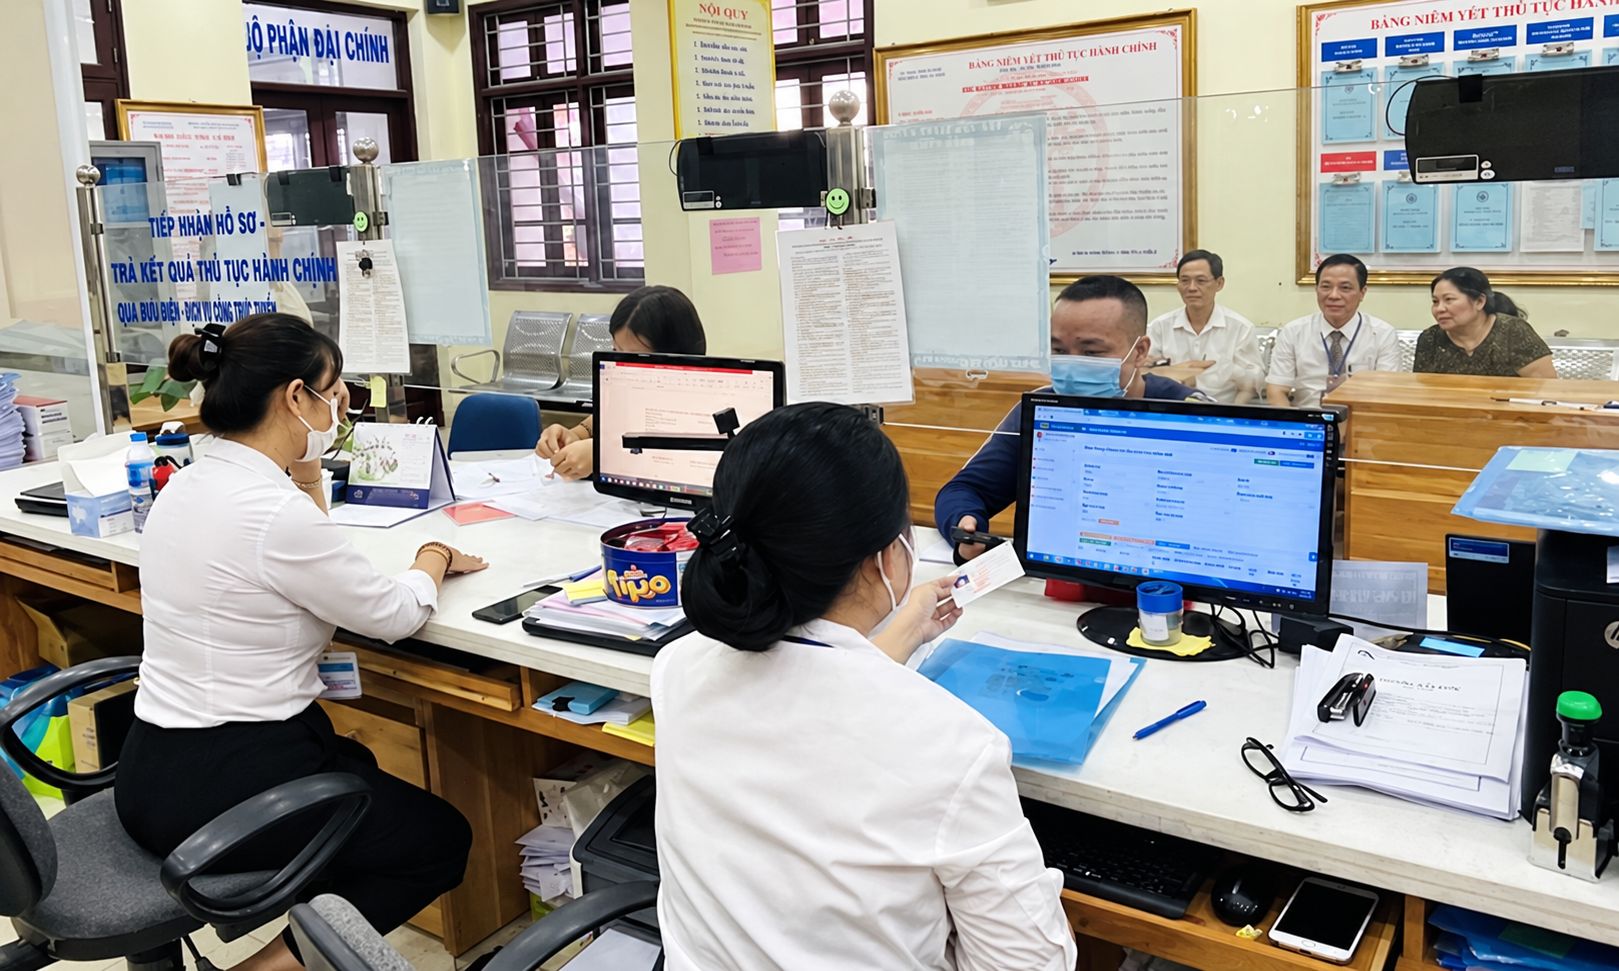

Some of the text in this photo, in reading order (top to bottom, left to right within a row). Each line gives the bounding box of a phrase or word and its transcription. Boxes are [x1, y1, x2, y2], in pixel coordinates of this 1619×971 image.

[699, 2, 748, 20] NỘI QUY
[1371, 14, 1410, 30] BẢNG
[1415, 10, 1453, 26] NIÊM
[1458, 5, 1489, 21] YẾT
[267, 18, 310, 62] PHẬN
[345, 26, 390, 63] CHÍNH
[1068, 48, 1087, 61] TỤC
[1090, 45, 1119, 57] HÀNH
[1122, 41, 1157, 53] CHÍNH
[148, 209, 175, 238] TIẾP
[238, 210, 257, 235] SƠ
[139, 254, 164, 283] KẾT
[168, 252, 195, 283] QUẢ
[196, 252, 222, 282] THỦ
[224, 258, 249, 287] TỤC
[252, 252, 290, 282] HÀNH
